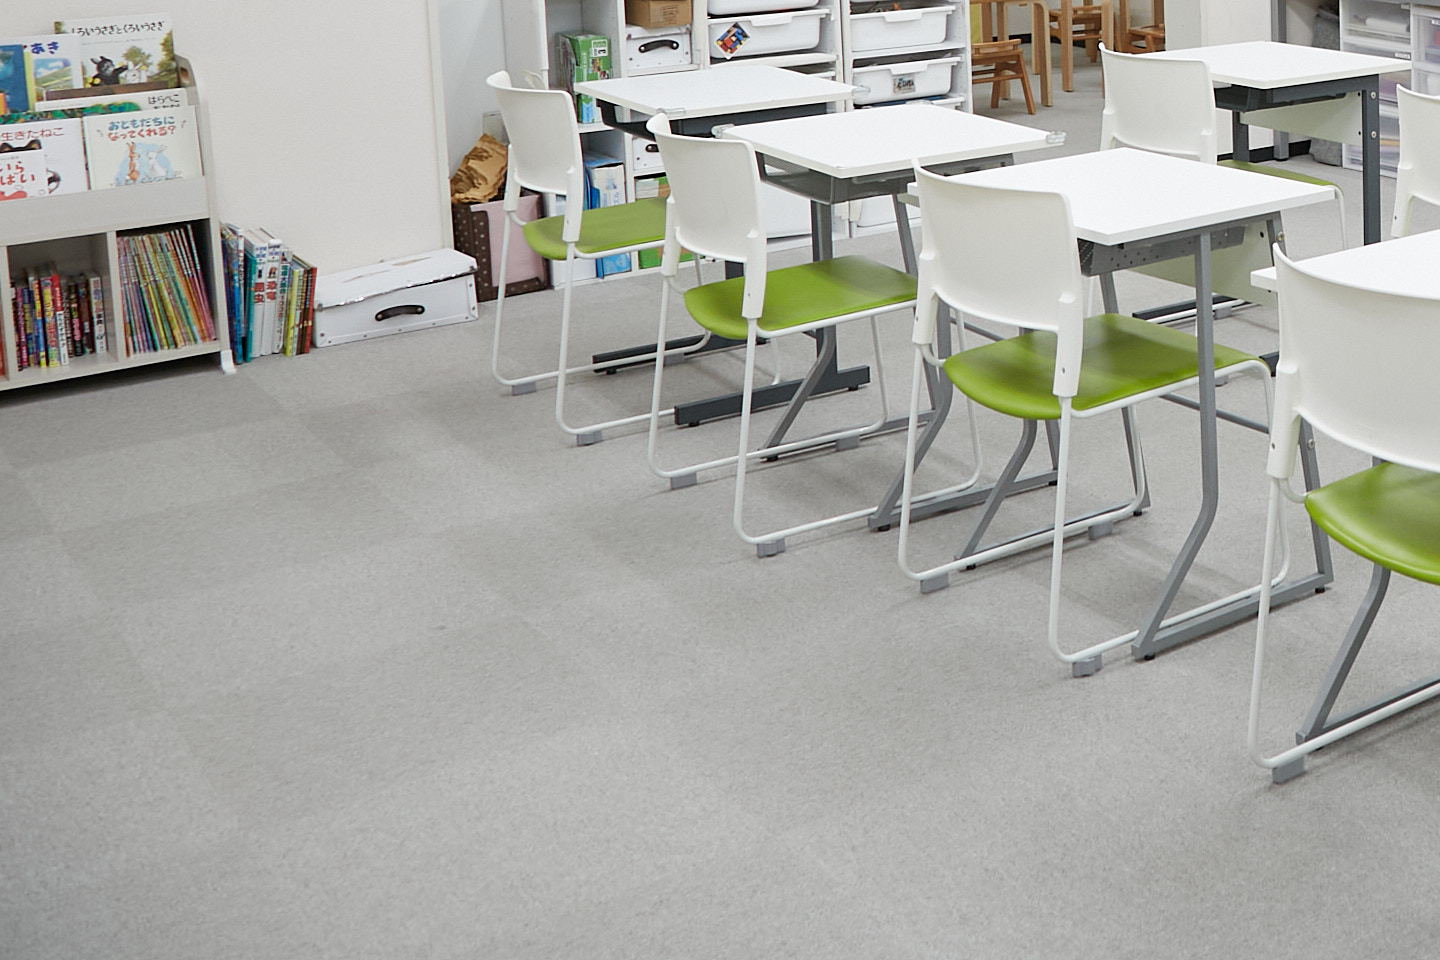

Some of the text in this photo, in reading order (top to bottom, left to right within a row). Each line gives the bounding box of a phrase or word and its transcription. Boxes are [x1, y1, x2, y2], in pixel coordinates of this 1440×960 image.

[30, 41, 60, 55] あき
[108, 116, 175, 132] おともだちに
[1, 127, 65, 141] 生きたねこ
[107, 126, 176, 141] なってくれる？
